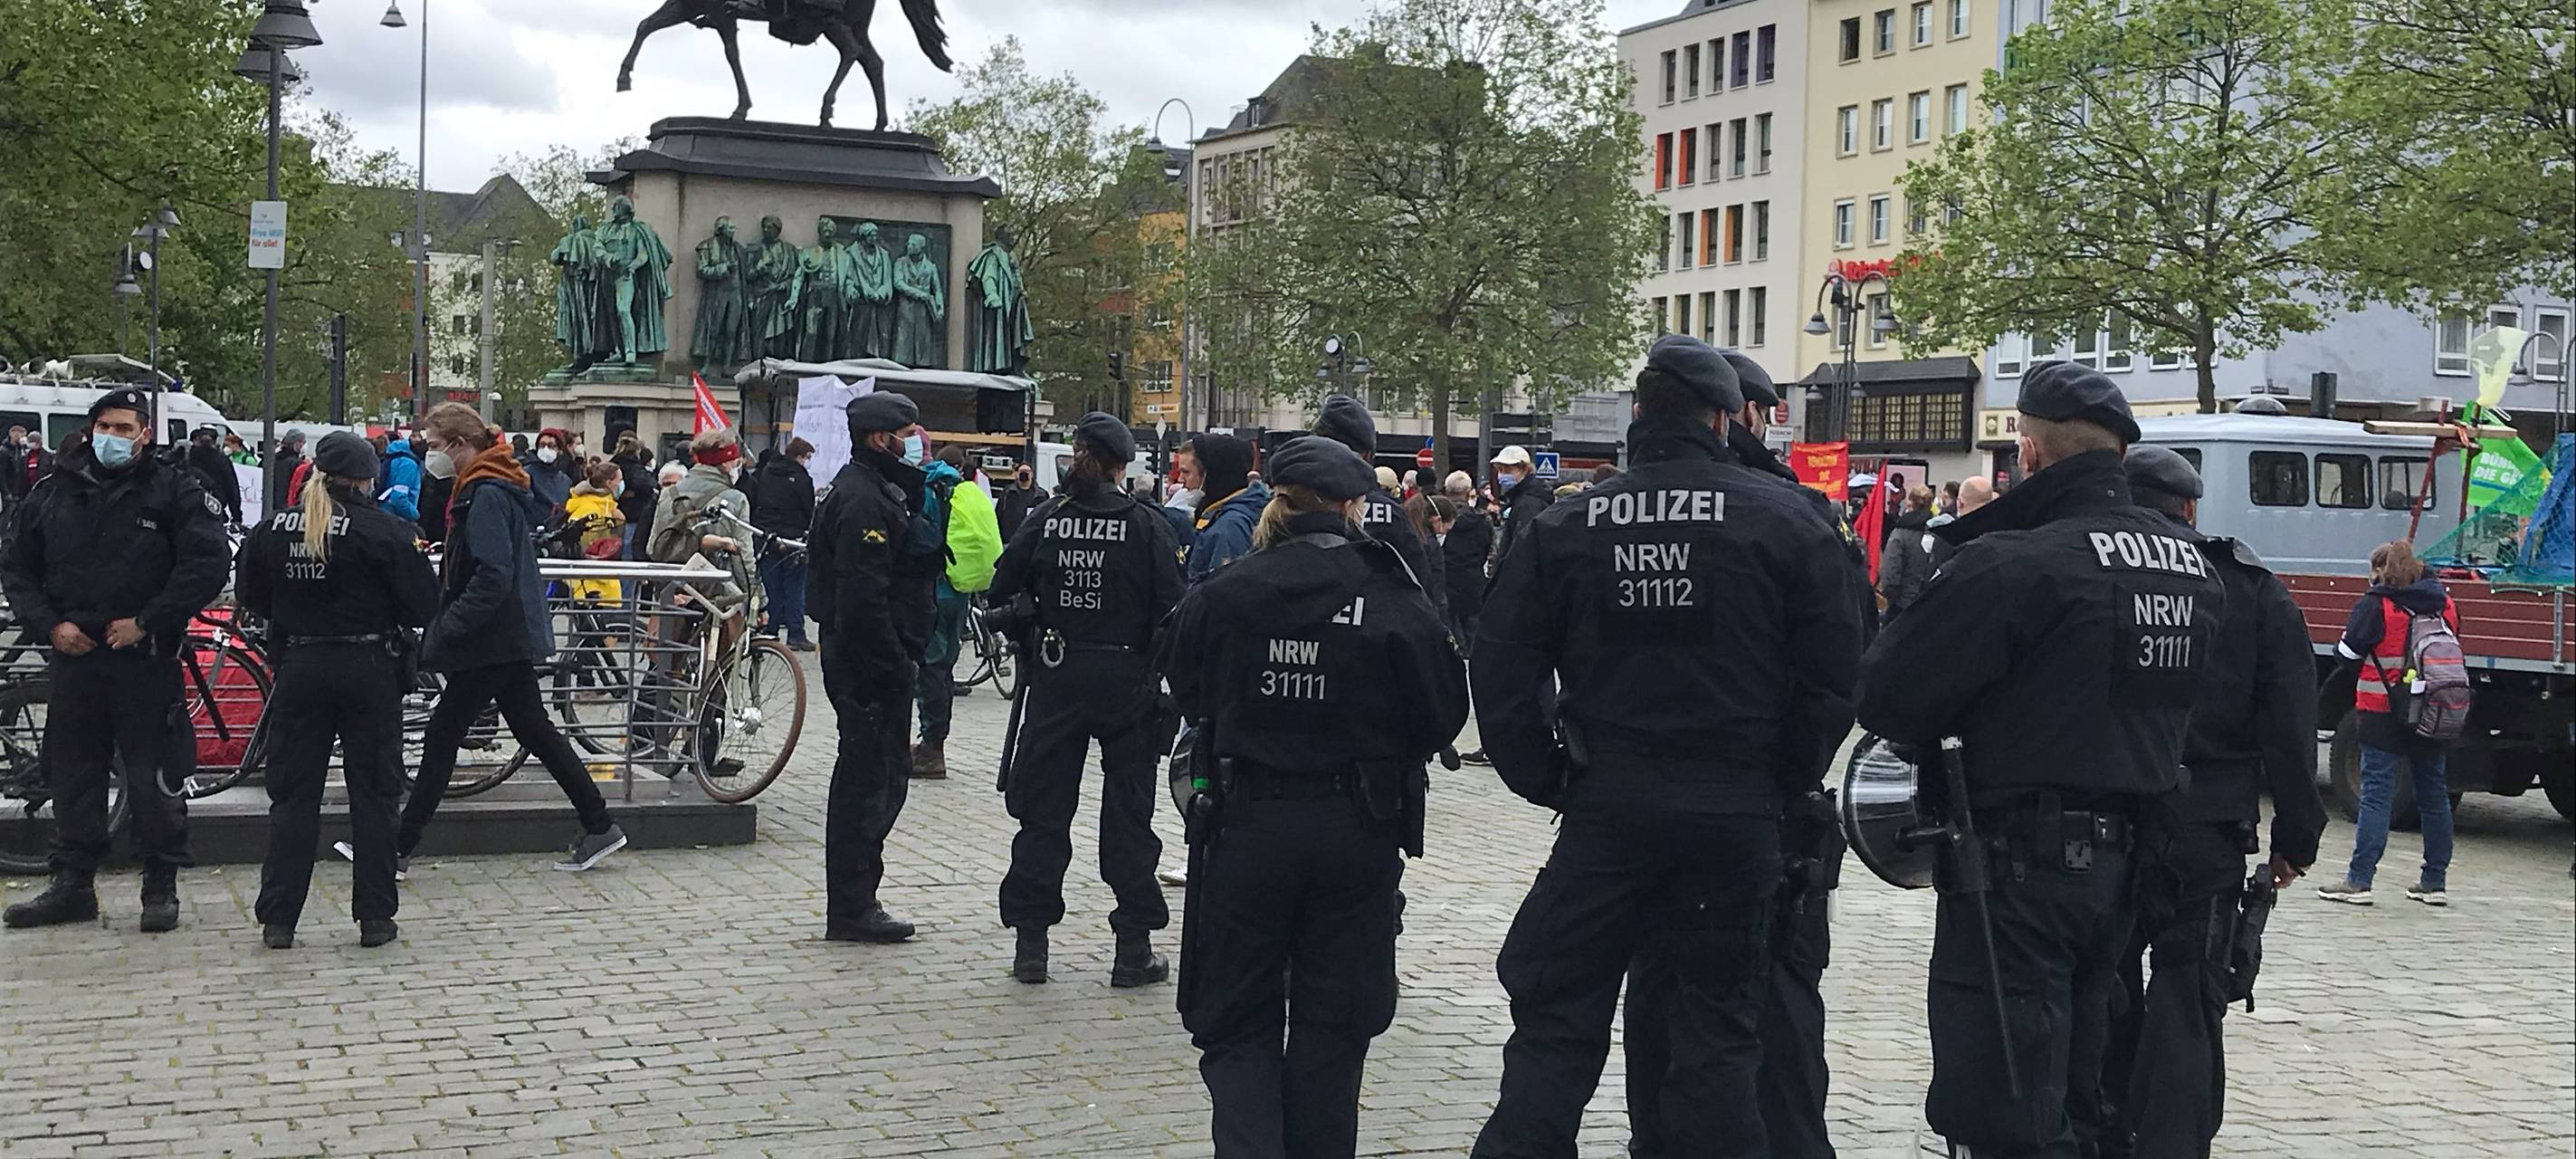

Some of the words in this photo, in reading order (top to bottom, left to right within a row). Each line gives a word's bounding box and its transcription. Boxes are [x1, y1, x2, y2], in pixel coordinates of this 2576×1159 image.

[2474, 465, 2497, 481] DIE
[1588, 489, 1725, 527] POLIZEI
[272, 512, 350, 536] POLEI
[1044, 517, 1127, 541] POLIZEI
[1058, 550, 1105, 568] NRW
[1614, 543, 1691, 572] NRW
[2088, 531, 2209, 579] POLIZEI
[285, 562, 326, 579] 31112
[1064, 570, 1102, 588] 3113
[1060, 589, 1102, 609] BeSi
[1618, 578, 1693, 607] 31112
[2134, 594, 2193, 627] NRW
[1269, 638, 1320, 665] NRW
[2138, 635, 2191, 667] 31111
[1260, 670, 1325, 700] 31111
